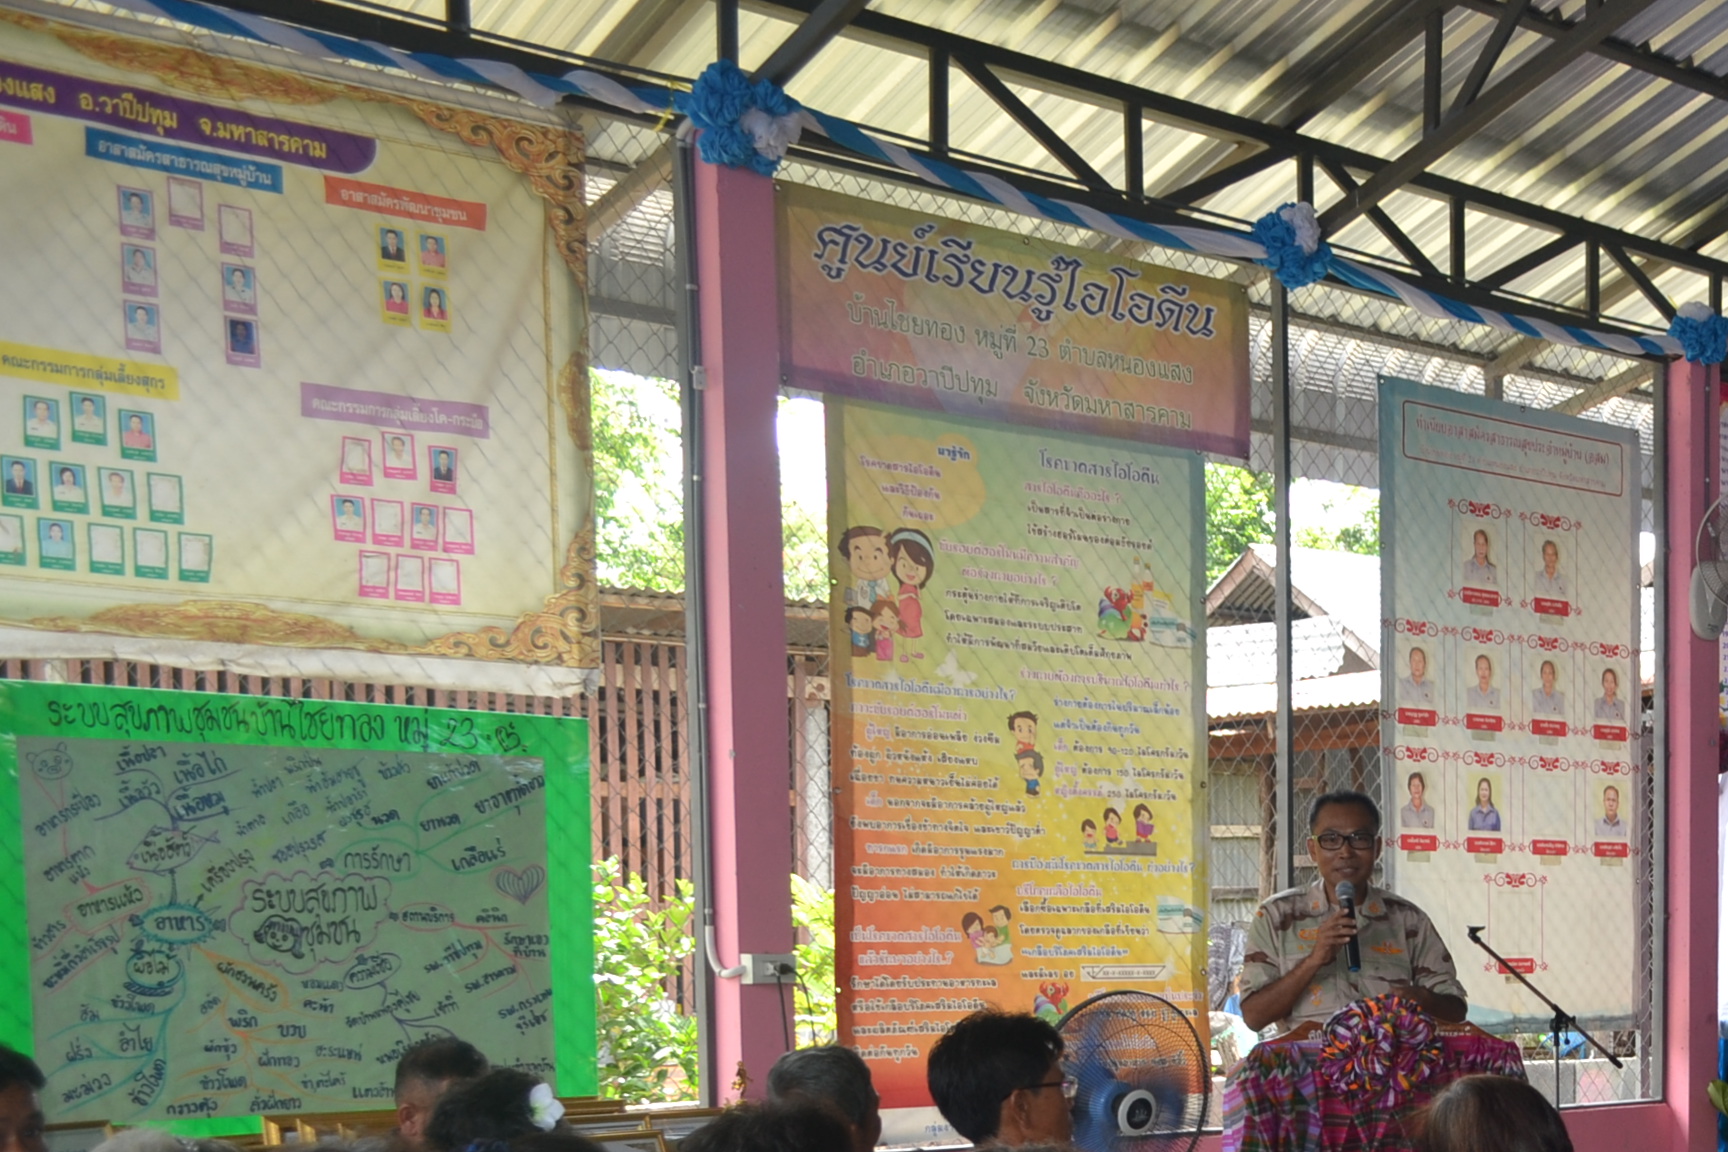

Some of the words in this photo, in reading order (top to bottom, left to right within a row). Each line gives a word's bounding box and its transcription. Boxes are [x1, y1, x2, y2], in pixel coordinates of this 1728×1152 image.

[0, 74, 56, 104] งแสง
[80, 92, 177, 136] อ.วาปีปทุม
[199, 115, 327, 159] จ.มหาสารคาม
[813, 220, 1219, 340] ศูนย์เรียนรู้ไอโอดีน
[846, 293, 967, 346] บ้านไชยทอง
[974, 322, 1018, 360] หมู่ที่
[1026, 335, 1050, 359] 23
[1059, 341, 1195, 384] ตำบลหนองแสง
[852, 352, 999, 406] อำเภอวาปีปทุม
[1024, 384, 1194, 430] จังหวัดมหาสารคาม
[1039, 448, 1161, 486] โรคขาดสารไอโอดีน
[440, 717, 479, 750] 23
[344, 844, 411, 873] การรักษา
[251, 884, 378, 920] ระบบสุขภาพ
[155, 915, 204, 932] อาหาร
[302, 916, 361, 962] ชุมชน
[228, 1010, 258, 1028] พริก
[277, 1024, 307, 1037] บวบ
[119, 1022, 154, 1052] ลำไย
[62, 1073, 112, 1103] มะม่วง
